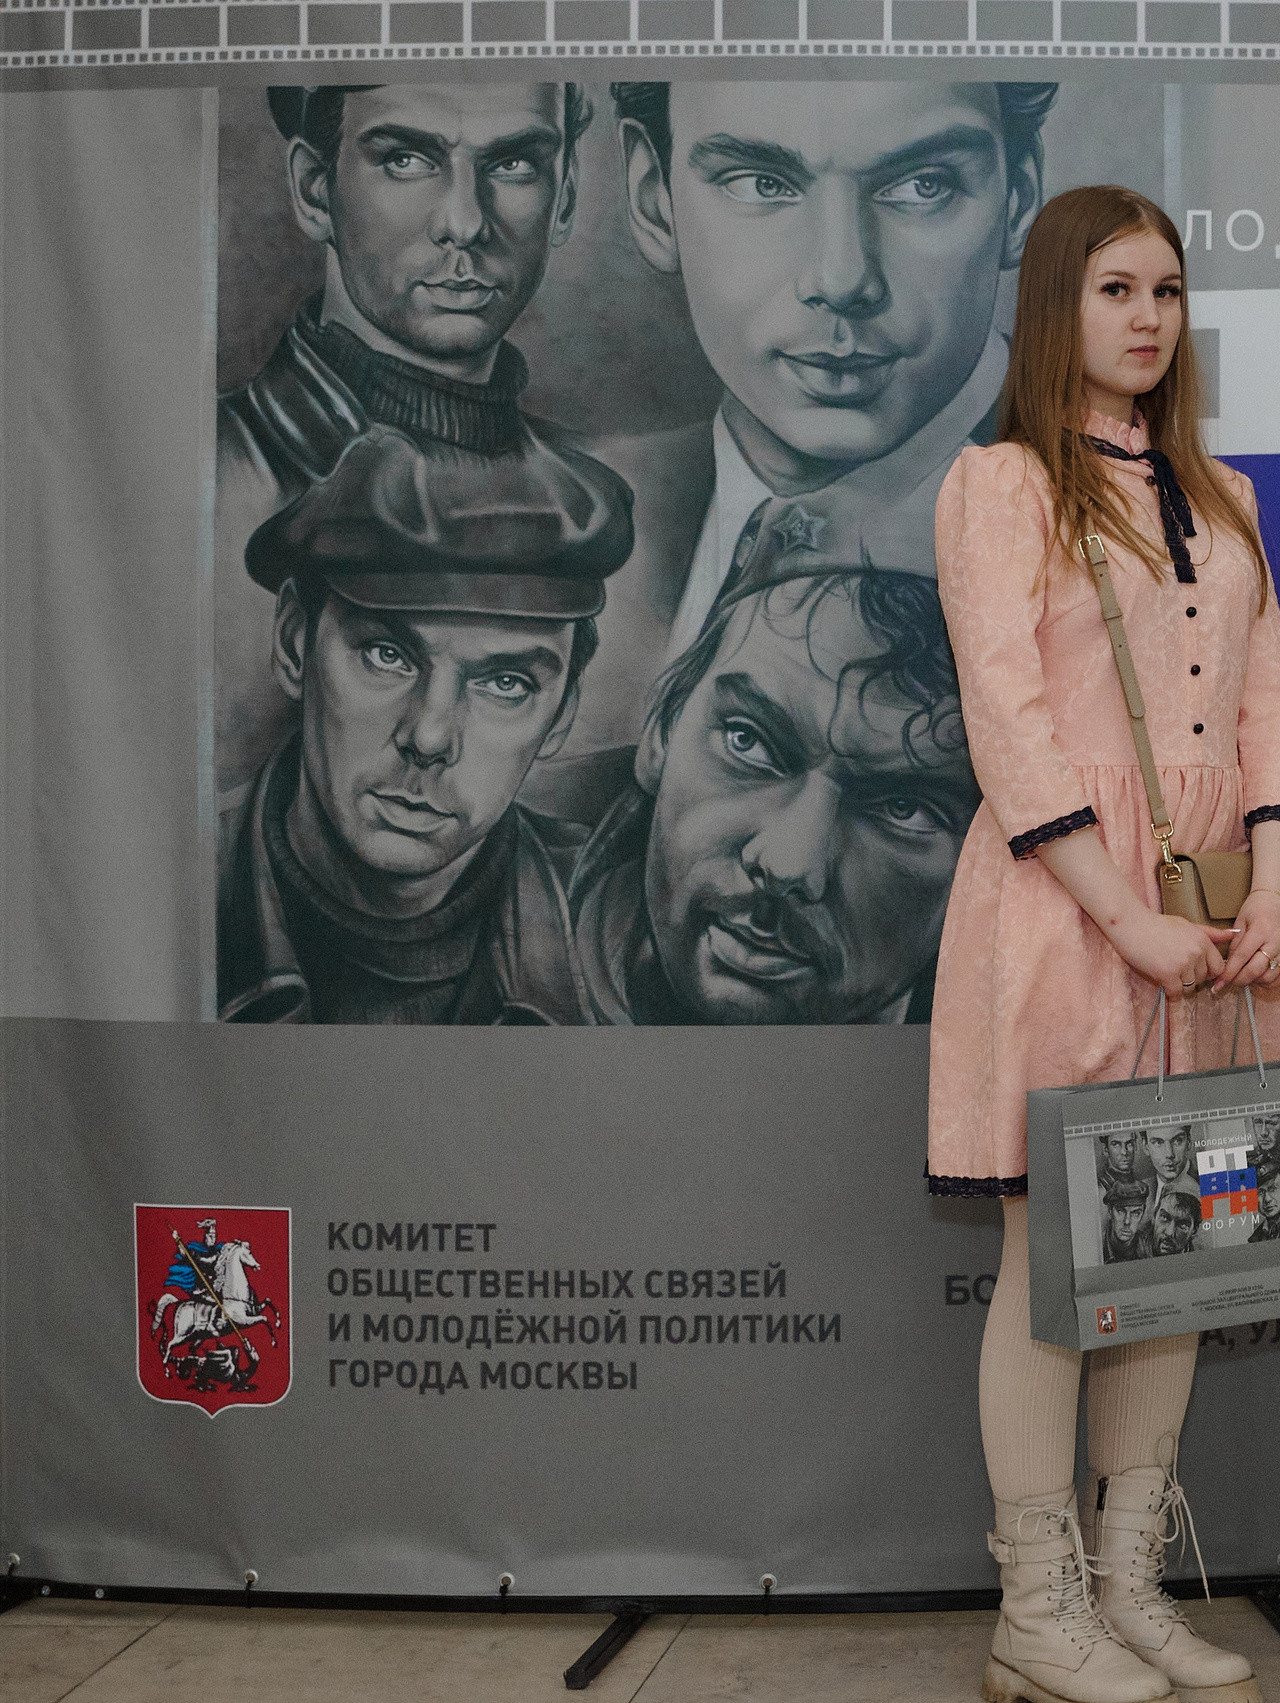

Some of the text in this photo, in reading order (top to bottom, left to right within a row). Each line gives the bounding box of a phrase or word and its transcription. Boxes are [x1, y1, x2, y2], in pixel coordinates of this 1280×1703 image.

[327, 1222, 497, 1252] КОМИТЕТ
[1202, 1214, 1260, 1230] ФОРУМ
[327, 1261, 788, 1303] ОБЩЕСТВЕННЫХ СВЯЗЕЙ
[329, 1308, 842, 1348] И МОЛОДЁЖНОЙ ПОЛИТИКИ
[329, 1360, 638, 1394] ГОРОДА МОСКВЫ
